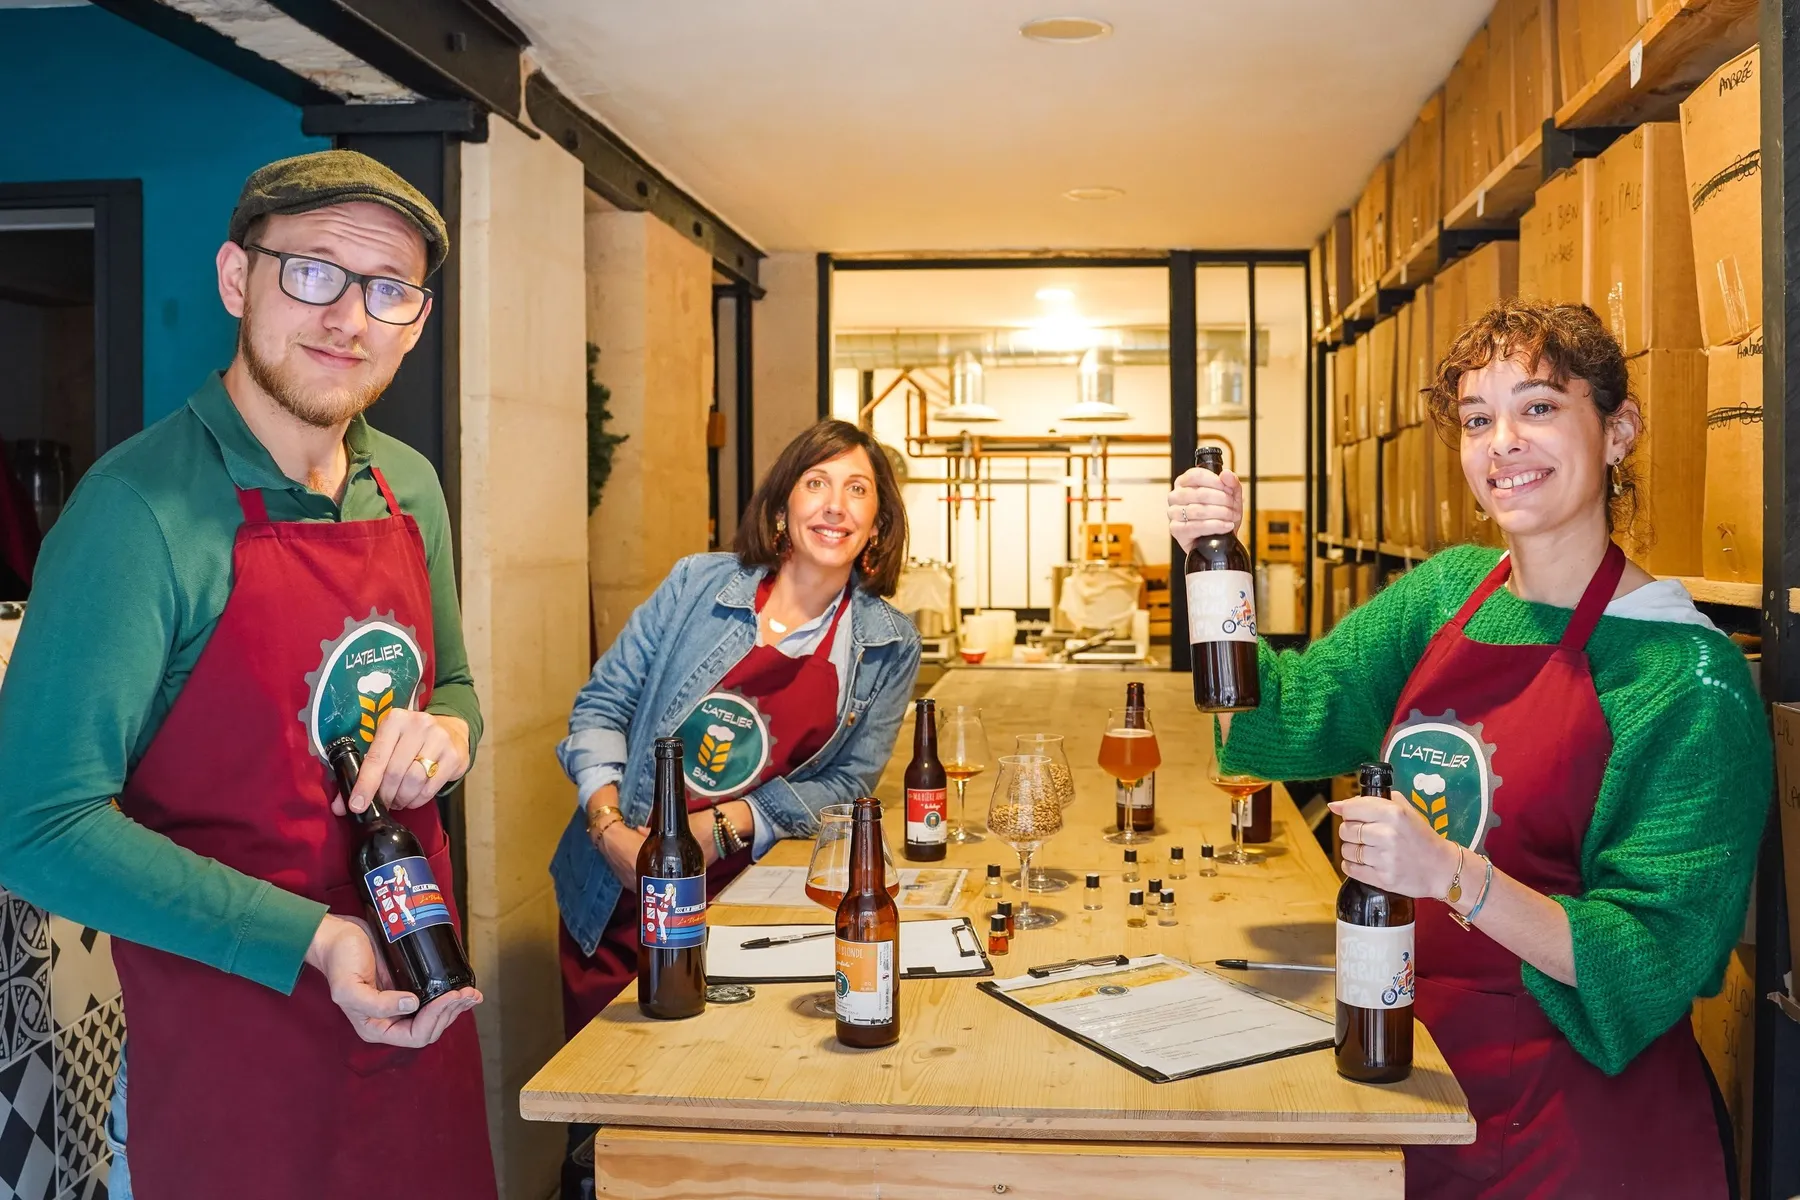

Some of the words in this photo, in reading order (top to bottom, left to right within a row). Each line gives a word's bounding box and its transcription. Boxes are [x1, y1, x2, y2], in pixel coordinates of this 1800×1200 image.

[345, 643, 404, 670] L'ATELIER
[701, 702, 754, 729] L'ATELIER
[1400, 742, 1470, 768] L'ATELIER
[692, 766, 717, 787] Bière
